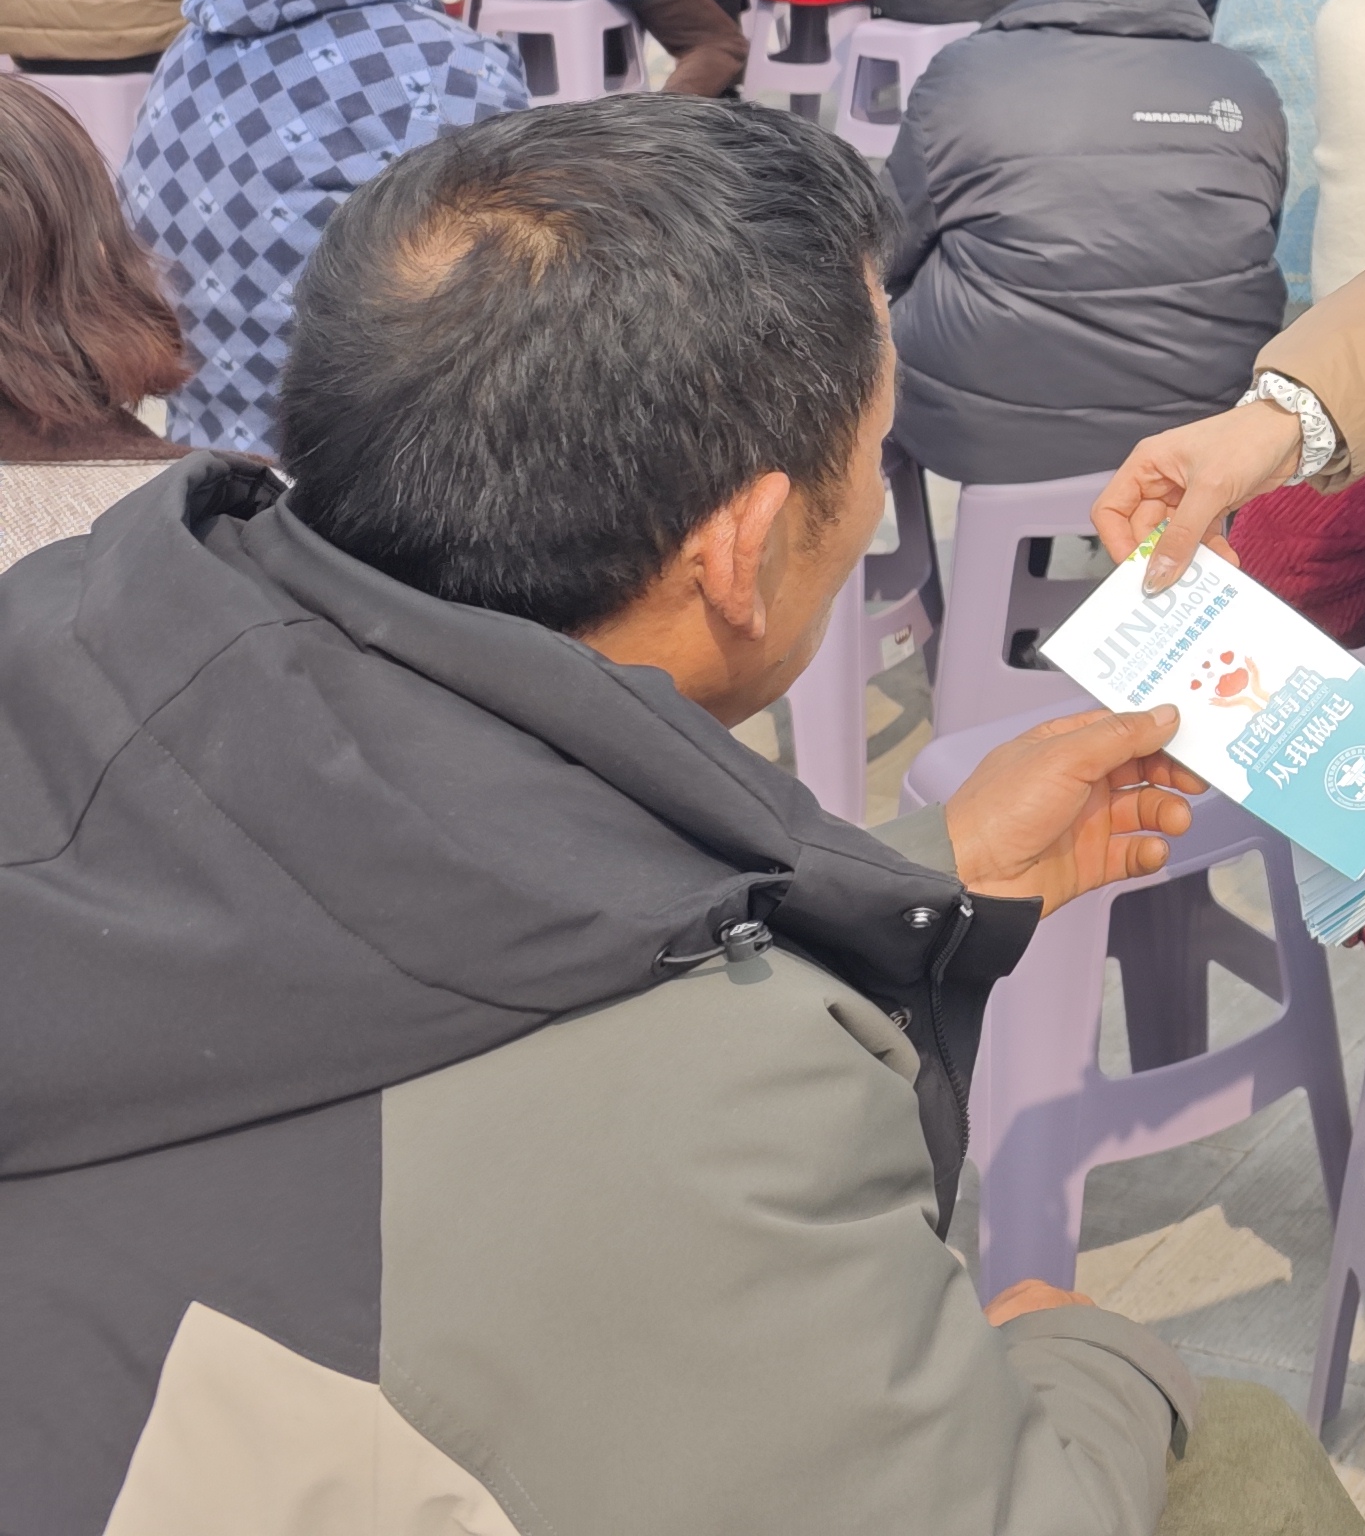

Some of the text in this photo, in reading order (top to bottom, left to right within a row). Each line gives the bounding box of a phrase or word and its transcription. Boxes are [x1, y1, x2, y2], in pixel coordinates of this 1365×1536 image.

[1127, 583, 1239, 706] 新精神活性物质滥用危害
[1230, 669, 1324, 766] 拒绝毒品
[1265, 693, 1355, 790] 从我做起
